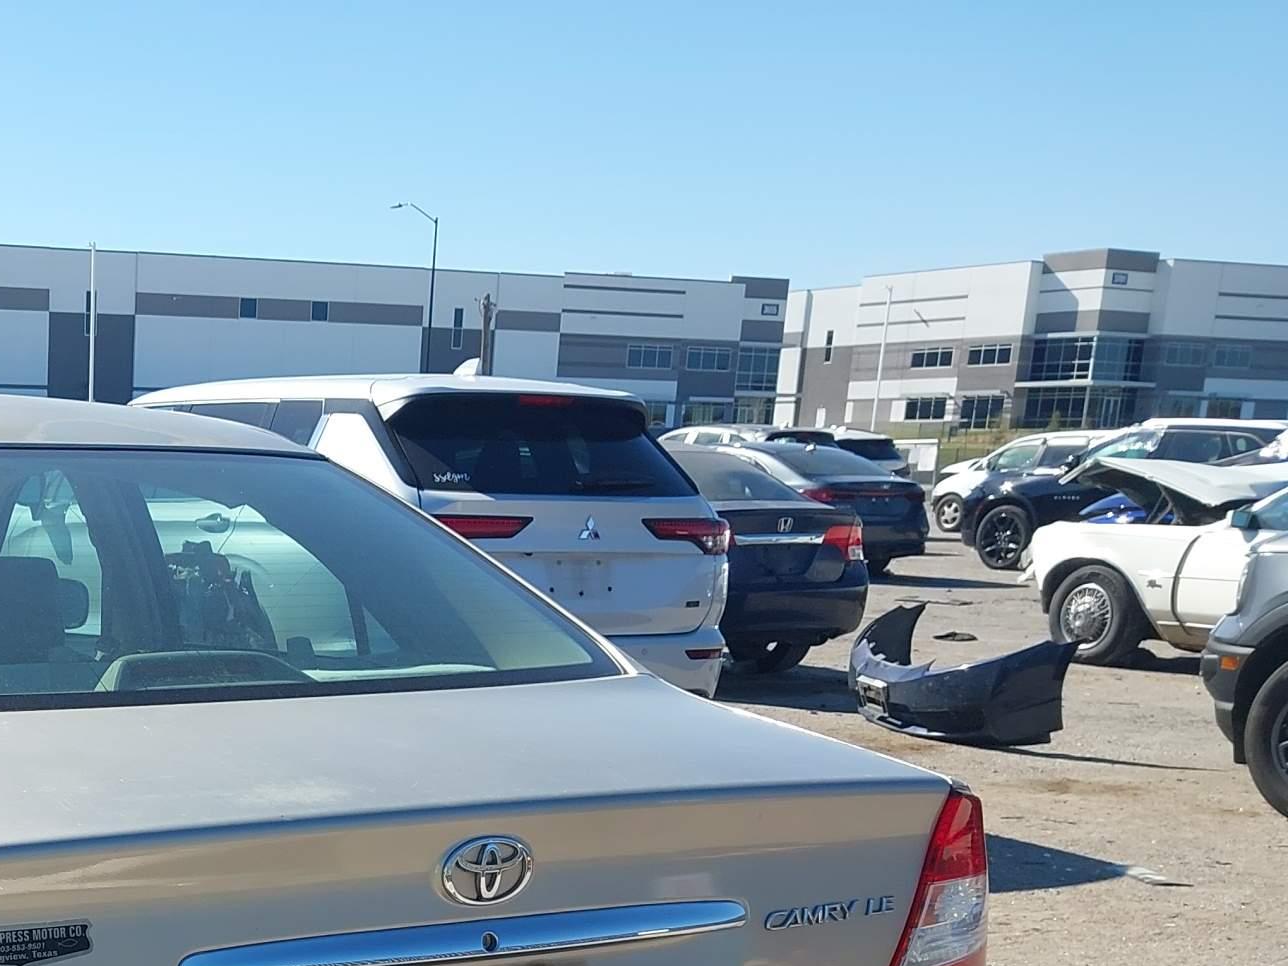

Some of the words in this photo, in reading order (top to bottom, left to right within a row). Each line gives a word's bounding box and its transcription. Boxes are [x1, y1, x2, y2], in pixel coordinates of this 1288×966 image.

[764, 899, 859, 931] CAMRY
[864, 895, 895, 916] LE
[32, 927, 66, 941] MOTOR
[69, 925, 85, 938] CO.
[32, 950, 58, 959] Texas
